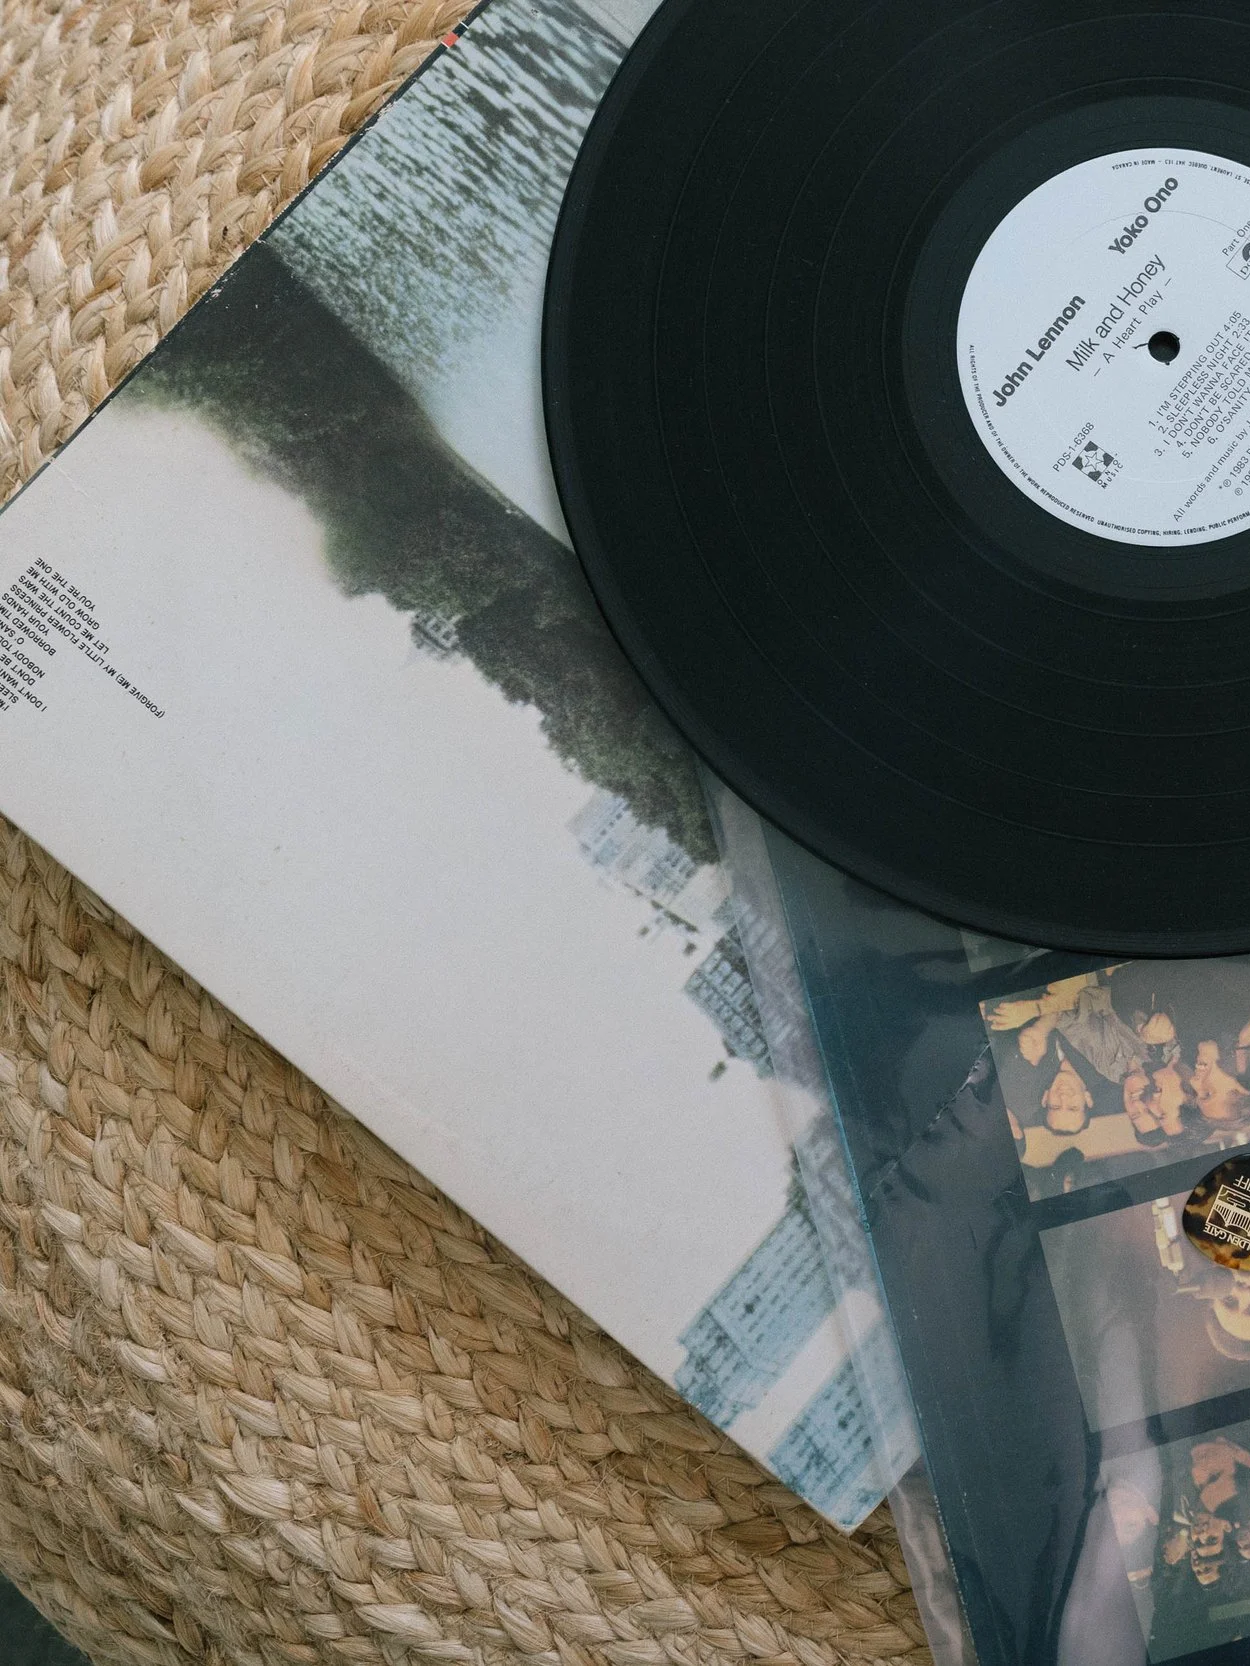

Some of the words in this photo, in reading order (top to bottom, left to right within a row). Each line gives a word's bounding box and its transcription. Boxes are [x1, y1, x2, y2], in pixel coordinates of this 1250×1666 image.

[1107, 214, 1149, 255] Yoko
[1143, 177, 1179, 213] Ono
[1221, 238, 1240, 257] Part
[1064, 337, 1100, 372] Milk
[1094, 302, 1125, 339] and
[1116, 253, 1166, 306] Honey
[1102, 352, 1115, 364] A
[1111, 317, 1142, 349] Heart
[1137, 289, 1164, 315] Play
[992, 361, 1034, 407] John
[1024, 295, 1086, 362] Lennon
[1156, 400, 1172, 417] I'M
[1168, 354, 1208, 401] STEPPING
[1205, 331, 1224, 354] OUT
[1223, 310, 1242, 332] 4:05
[1157, 425, 1169, 434] 2.
[1165, 370, 1209, 423] SLEEPLESS
[1206, 337, 1233, 371] NIGHT
[1231, 317, 1250, 339] 2:33
[1153, 448, 1166, 457] 3.
[1167, 406, 1194, 439] DON'T
[1191, 371, 1225, 407] WANNA
[1221, 342, 1245, 370] FACE
[1175, 440, 1187, 448] 4.
[1183, 405, 1210, 437] DON'T
[1207, 390, 1222, 406] BE
[1181, 449, 1193, 459] 5.
[1189, 405, 1223, 448] NOBODY
[1221, 378, 1246, 405] TOLD
[1052, 421, 1095, 472] PDS-1-6368
[1206, 435, 1218, 445] 6.
[1100, 462, 1123, 489] MUSIC
[1172, 507, 1186, 522] All
[1183, 482, 1206, 508] words
[1204, 463, 1219, 483] and
[1216, 440, 1239, 466] music
[1234, 427, 1248, 441] by
[1229, 455, 1249, 478] 1983
[25, 566, 40, 579] ME
[33, 557, 53, 574] ONE
[18, 574, 39, 595] WAYS
[38, 576, 59, 596] WITH
[50, 571, 68, 588] THE
[1, 592, 29, 618] HANDS
[9, 583, 48, 618] PRINCESS
[37, 591, 55, 609] THE
[58, 593, 76, 610] OLD
[66, 584, 96, 612] YOU'RE
[0, 603, 12, 620] TIM
[53, 606, 82, 630] COUNT
[74, 608, 100, 630] GROW
[0, 619, 16, 638] SAN
[11, 617, 56, 656] BORROWED
[27, 614, 50, 636] YOUR
[46, 614, 80, 645] FLOWER
[80, 628, 95, 642] ME
[77, 641, 105, 666] LITTLE
[92, 639, 109, 654] LET
[0, 653, 12, 666] BE
[11, 649, 46, 678] NOBODY
[102, 664, 117, 677] MY
[9, 664, 36, 686] DON'T
[114, 673, 131, 689] ME)
[0, 682, 19, 704] SLEE
[17, 686, 43, 709] DON'T
[128, 686, 165, 719] (FORGIVE
[1203, 1224, 1227, 1241] GATE
